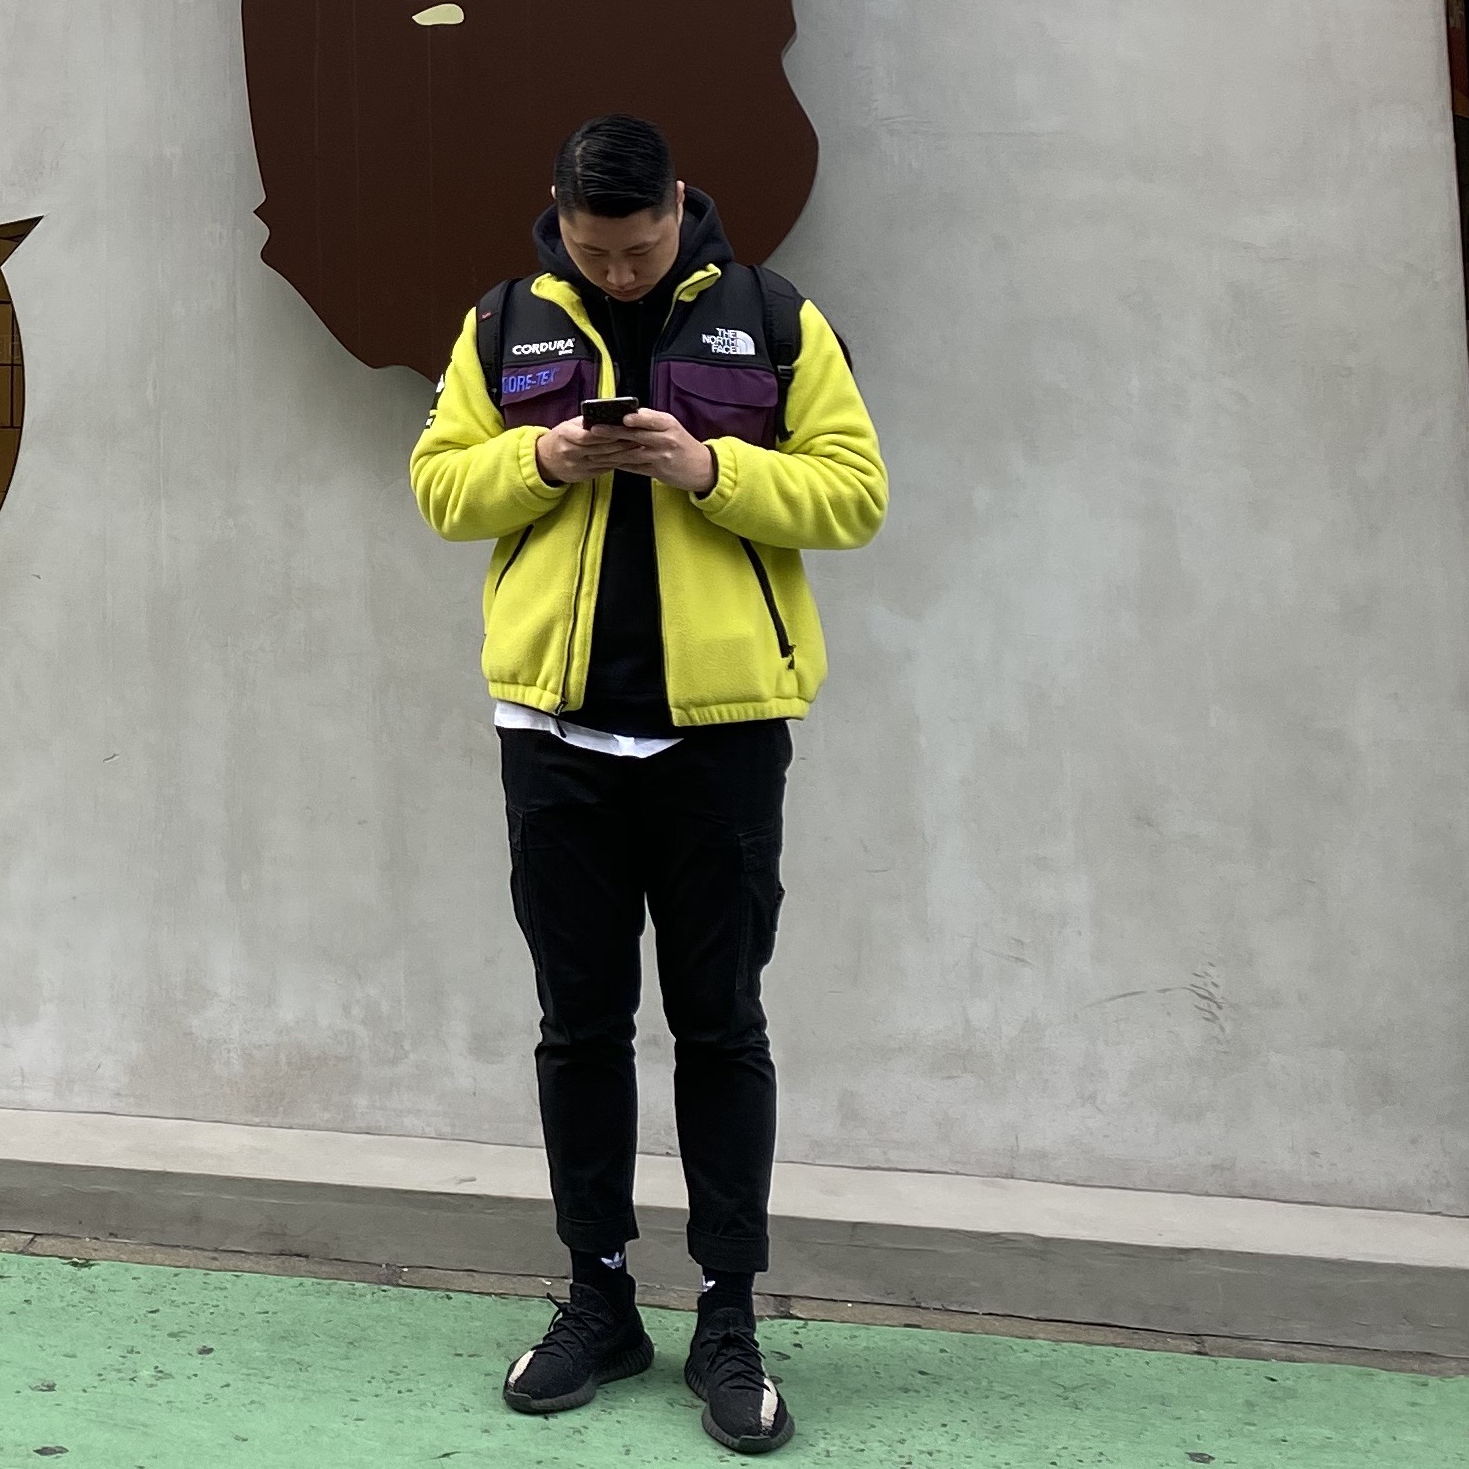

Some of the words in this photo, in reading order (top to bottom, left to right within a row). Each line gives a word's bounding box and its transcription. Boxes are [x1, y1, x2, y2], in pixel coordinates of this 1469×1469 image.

[716, 328, 737, 339] THE
[701, 334, 737, 347] NORTH
[712, 345, 737, 354] FACE
